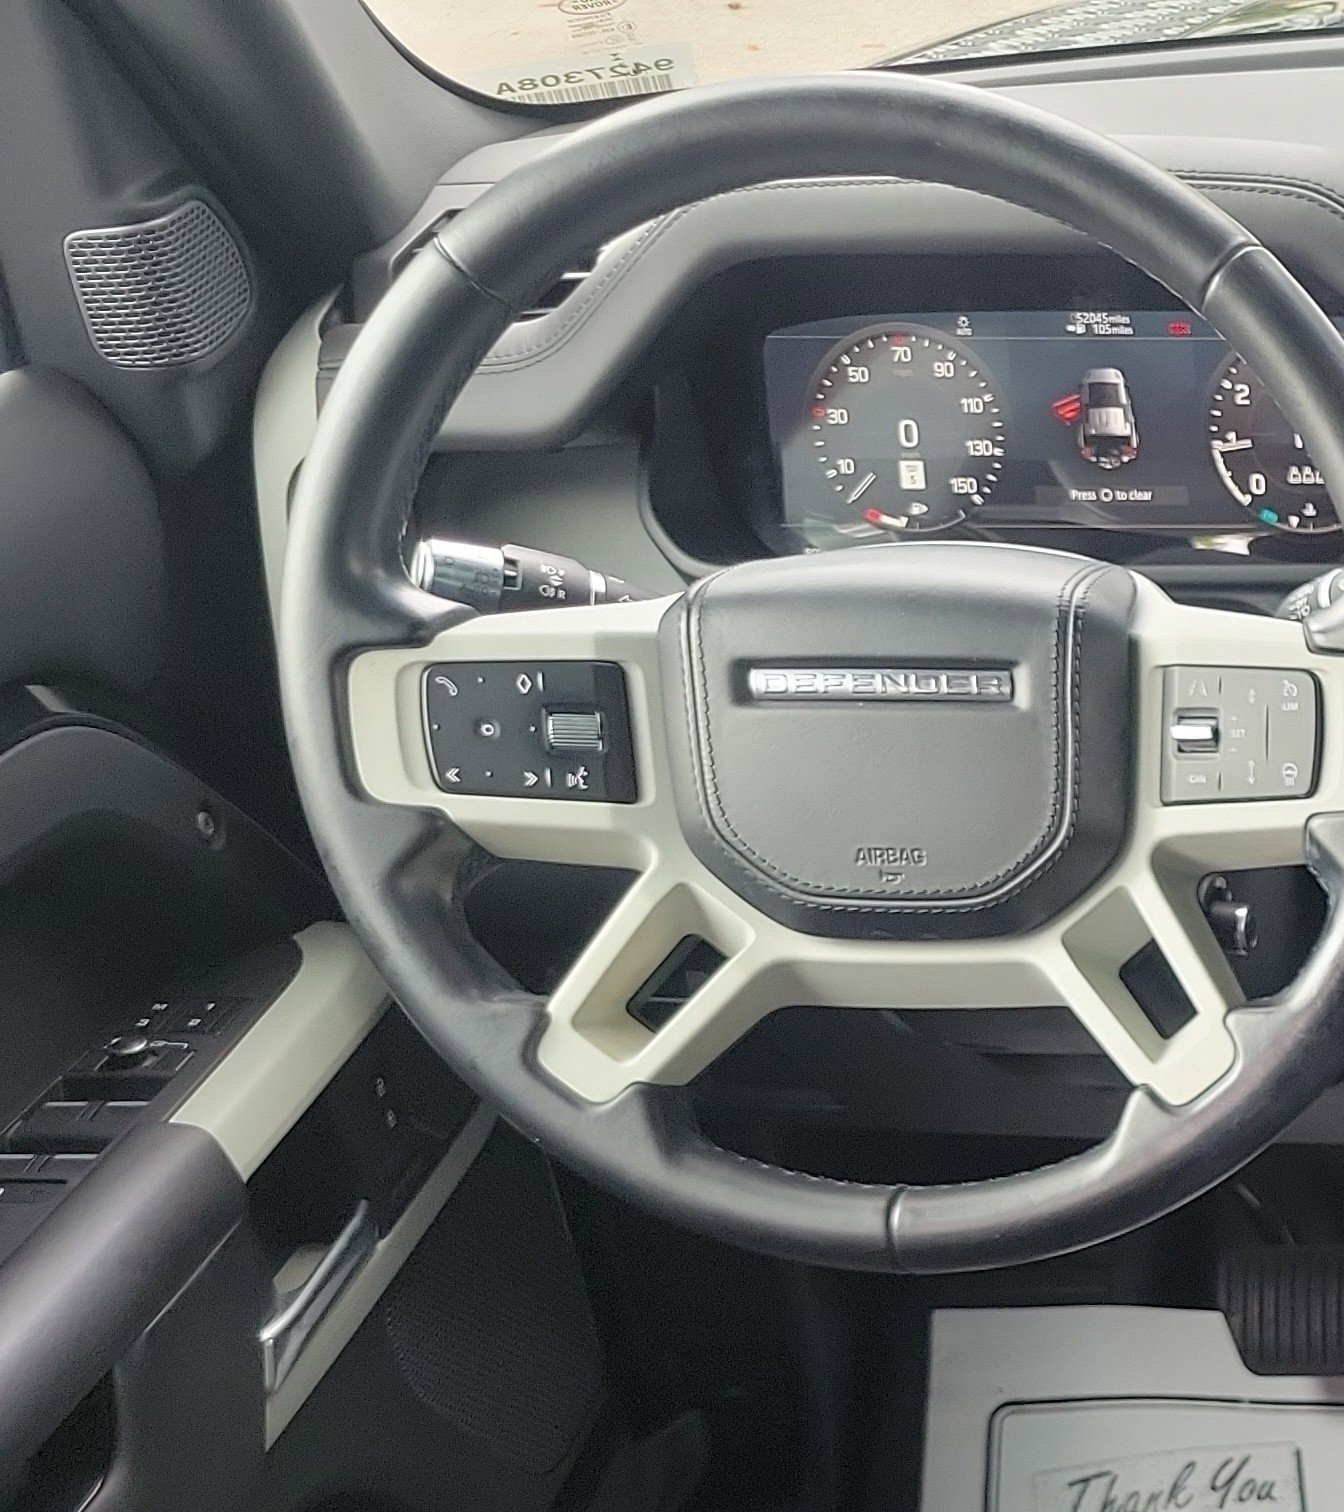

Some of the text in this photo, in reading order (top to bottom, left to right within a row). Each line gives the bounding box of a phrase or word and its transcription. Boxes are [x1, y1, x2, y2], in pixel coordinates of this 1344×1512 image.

[891, 346, 912, 362] 70
[848, 366, 869, 383] 50
[933, 362, 955, 378] 90
[1234, 384, 1250, 405] 2
[960, 398, 984, 414] 110
[826, 408, 848, 425] 30
[899, 419, 919, 448] 0
[966, 439, 993, 456] 130
[836, 458, 855, 475] 10
[949, 477, 978, 494] 150
[1249, 473, 1267, 495] 0
[1071, 489, 1153, 501] Press to clear
[762, 672, 1006, 695] DEFENDER
[854, 847, 927, 867] AIRBAG
[1209, 1454, 1278, 1510] You
